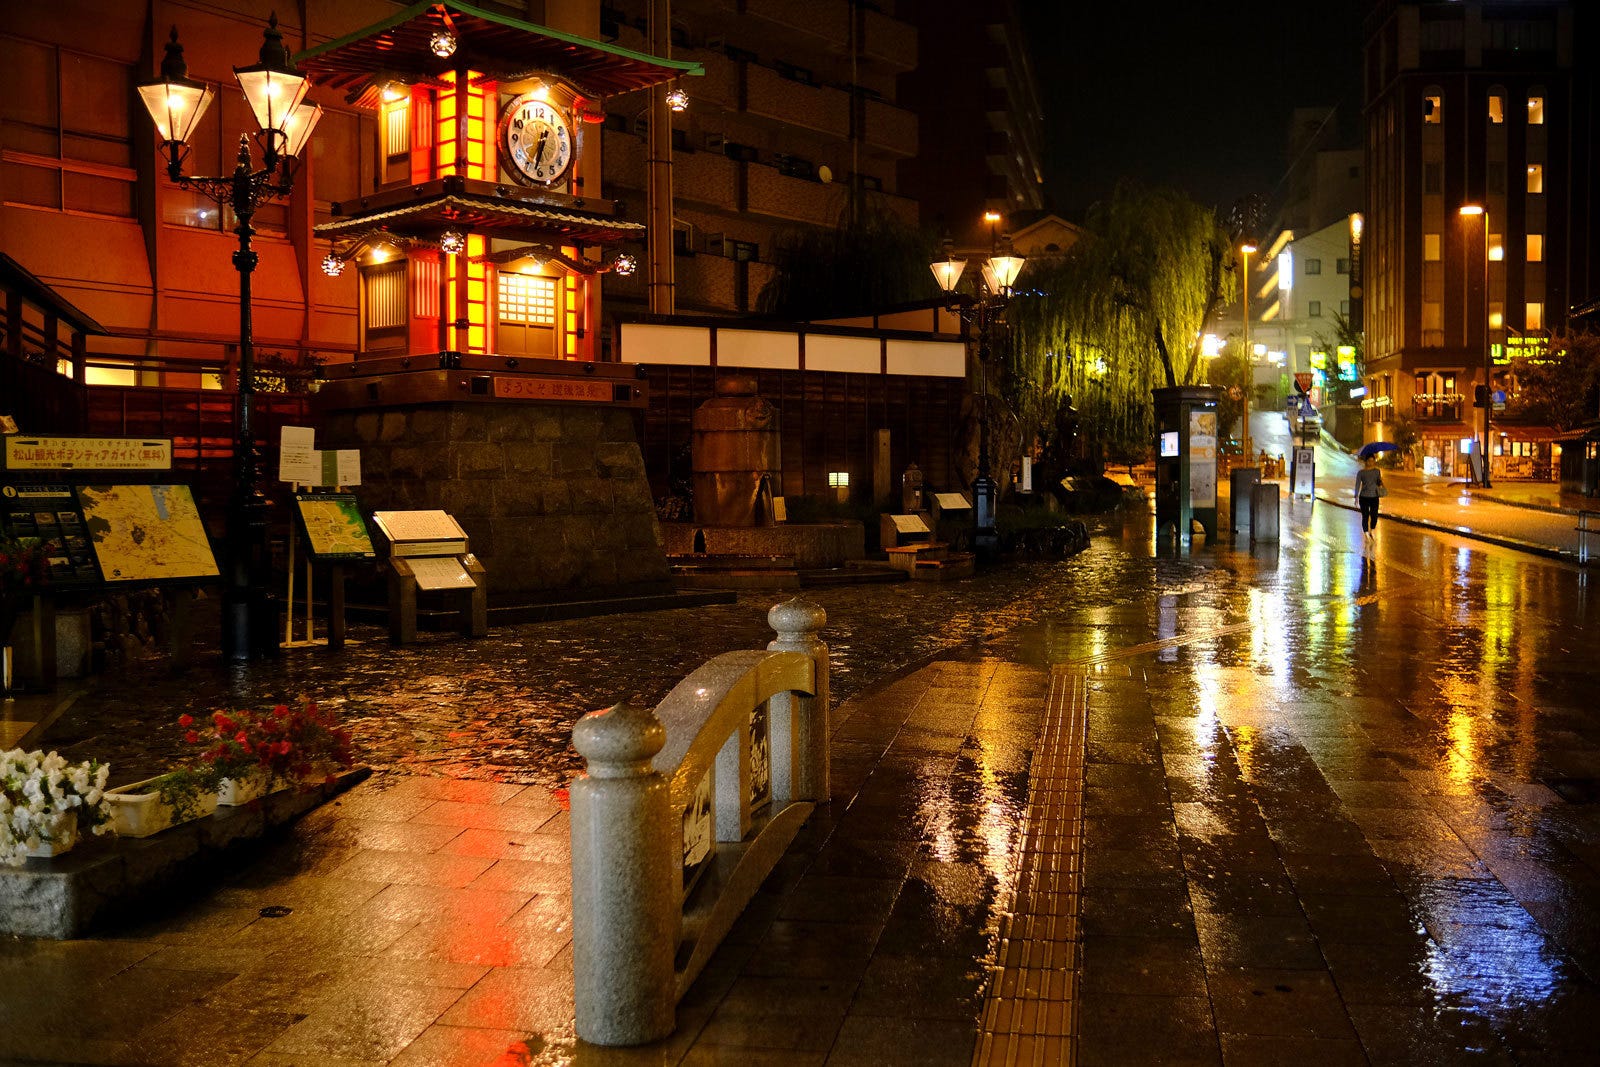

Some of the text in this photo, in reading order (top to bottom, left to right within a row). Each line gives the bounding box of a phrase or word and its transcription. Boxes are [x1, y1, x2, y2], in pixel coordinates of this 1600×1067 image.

[522, 110, 530, 120] 11
[535, 108, 545, 118] 12
[513, 119, 524, 129] 10
[512, 134, 518, 143] 9
[537, 168, 543, 177] 6
[549, 165, 555, 175] 5
